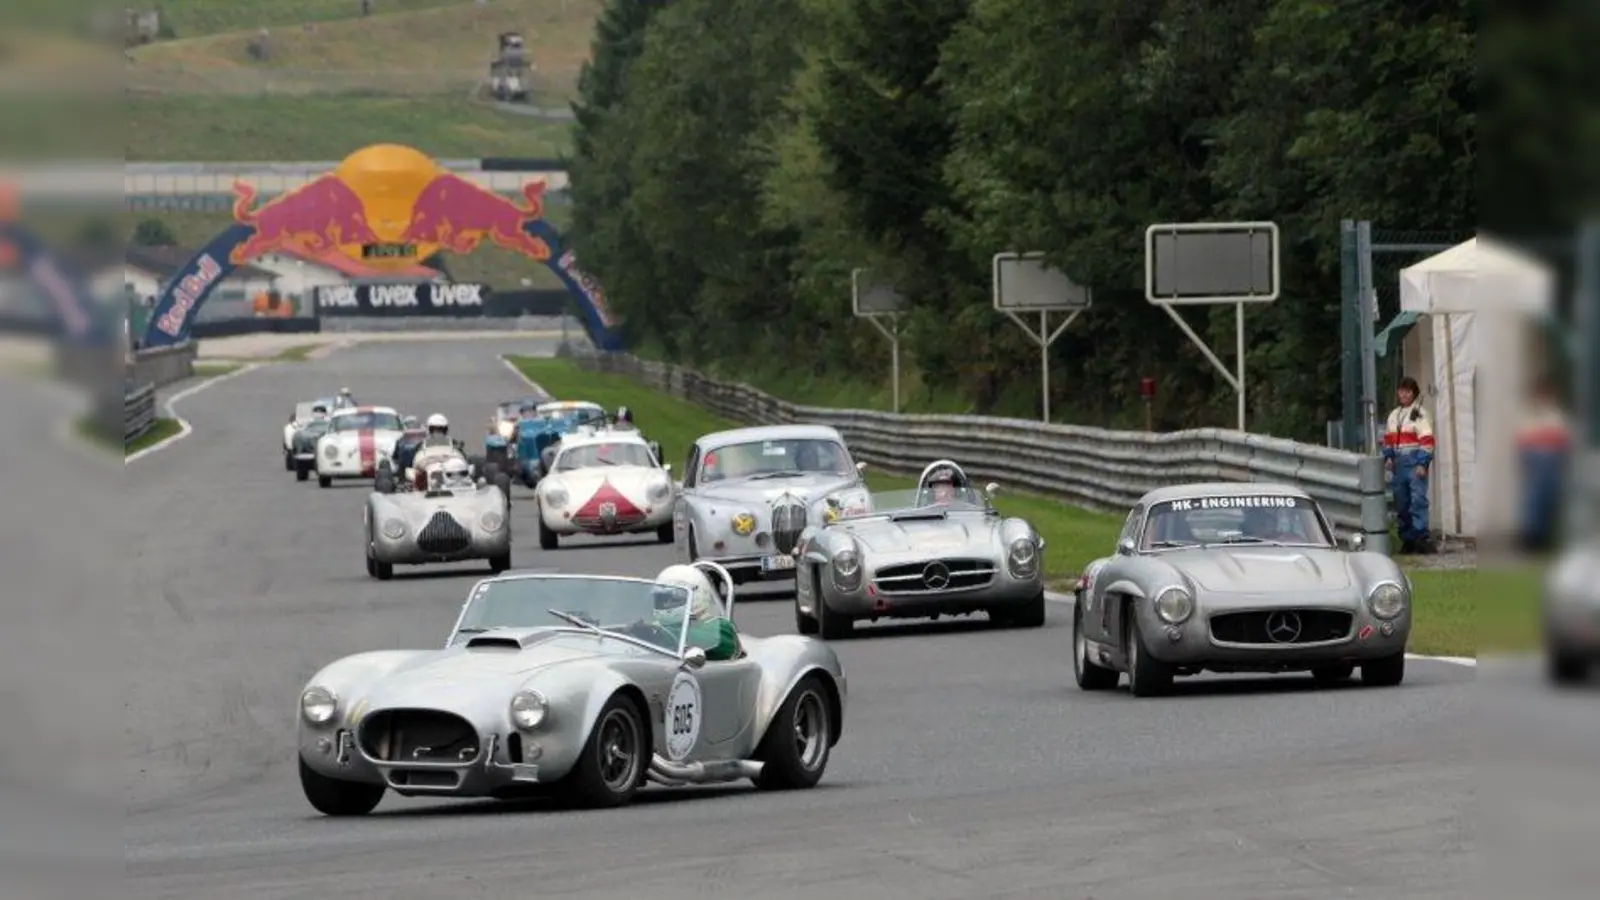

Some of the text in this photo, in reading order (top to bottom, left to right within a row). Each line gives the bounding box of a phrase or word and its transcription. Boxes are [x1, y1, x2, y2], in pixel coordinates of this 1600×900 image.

[157, 254, 221, 337] Red Bull
[369, 284, 419, 308] uvex
[430, 283, 483, 307] uvex
[1171, 497, 1297, 511] HK-ENGINEERING
[673, 703, 694, 735] 605
